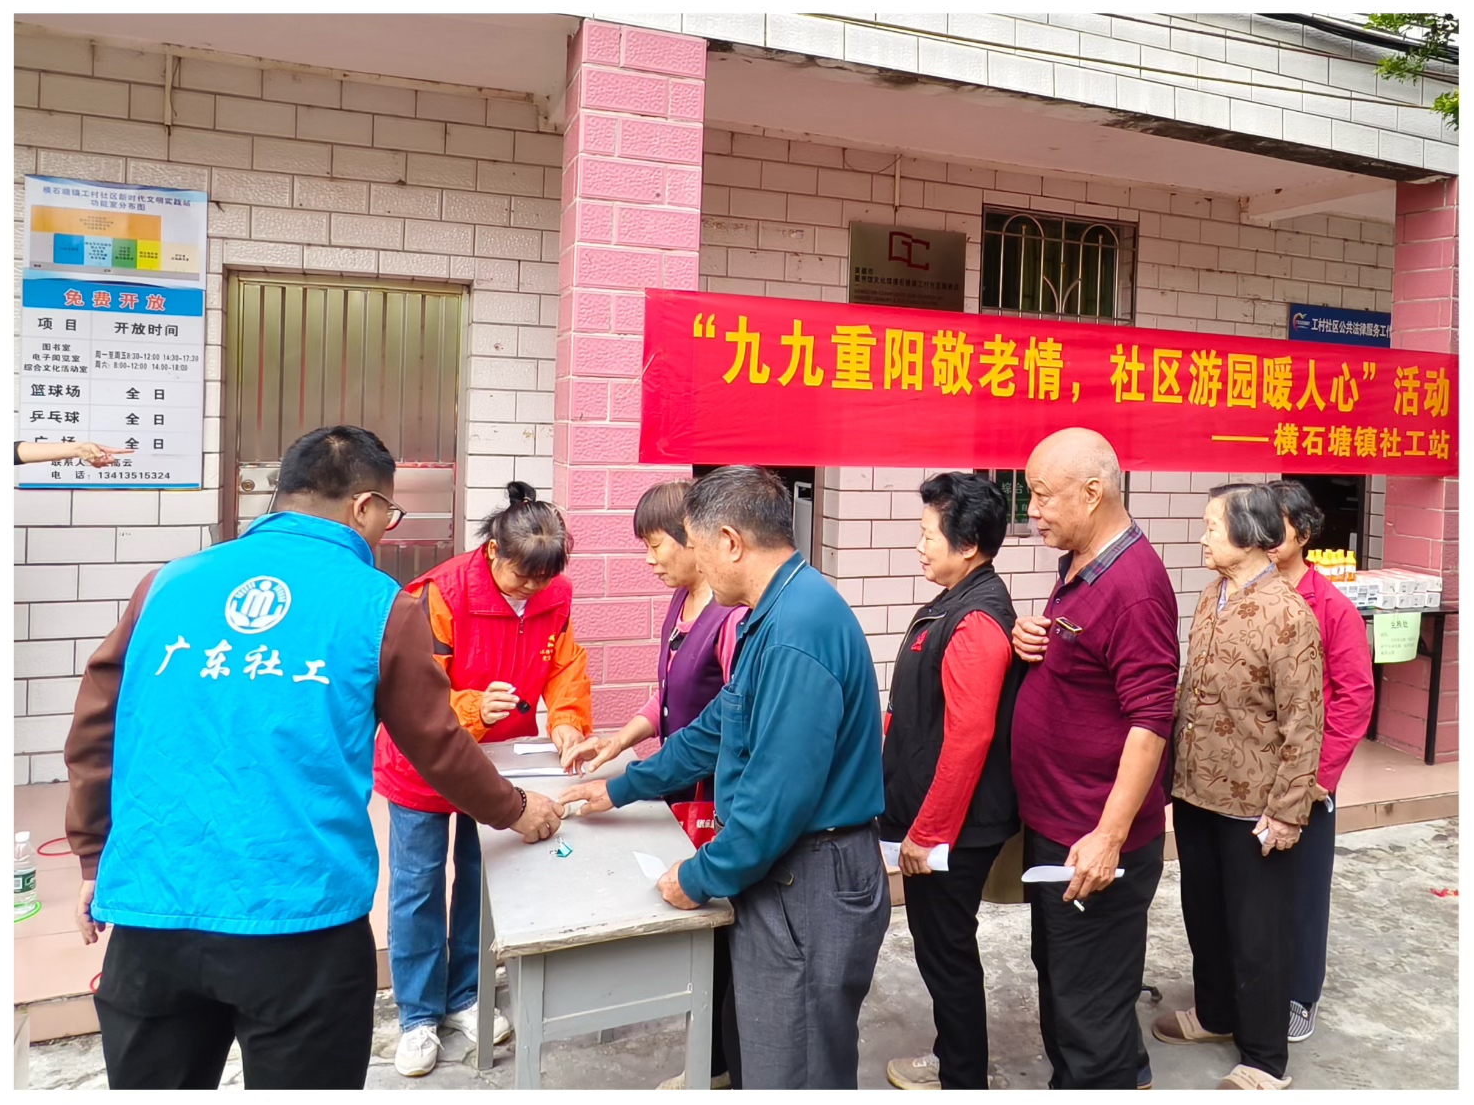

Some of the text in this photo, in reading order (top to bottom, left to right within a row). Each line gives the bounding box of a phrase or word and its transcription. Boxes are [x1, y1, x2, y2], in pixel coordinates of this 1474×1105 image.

[64, 288, 167, 311] 免费开放
[114, 321, 179, 336] 开放时间
[41, 343, 71, 352] 图书室
[32, 353, 81, 363] 电子阅览室
[692, 312, 1450, 418] “九九重阳敬老情，社区游园暖人心” 活动
[23, 363, 88, 373] 综合文化活动室
[30, 383, 81, 398] 篮球场
[126, 387, 165, 400] 全日
[29, 410, 80, 424] 乒乓球
[125, 412, 165, 426] 全日
[124, 437, 165, 450] 全日
[98, 471, 171, 479] 13413515324
[154, 634, 331, 685] 广东社工
